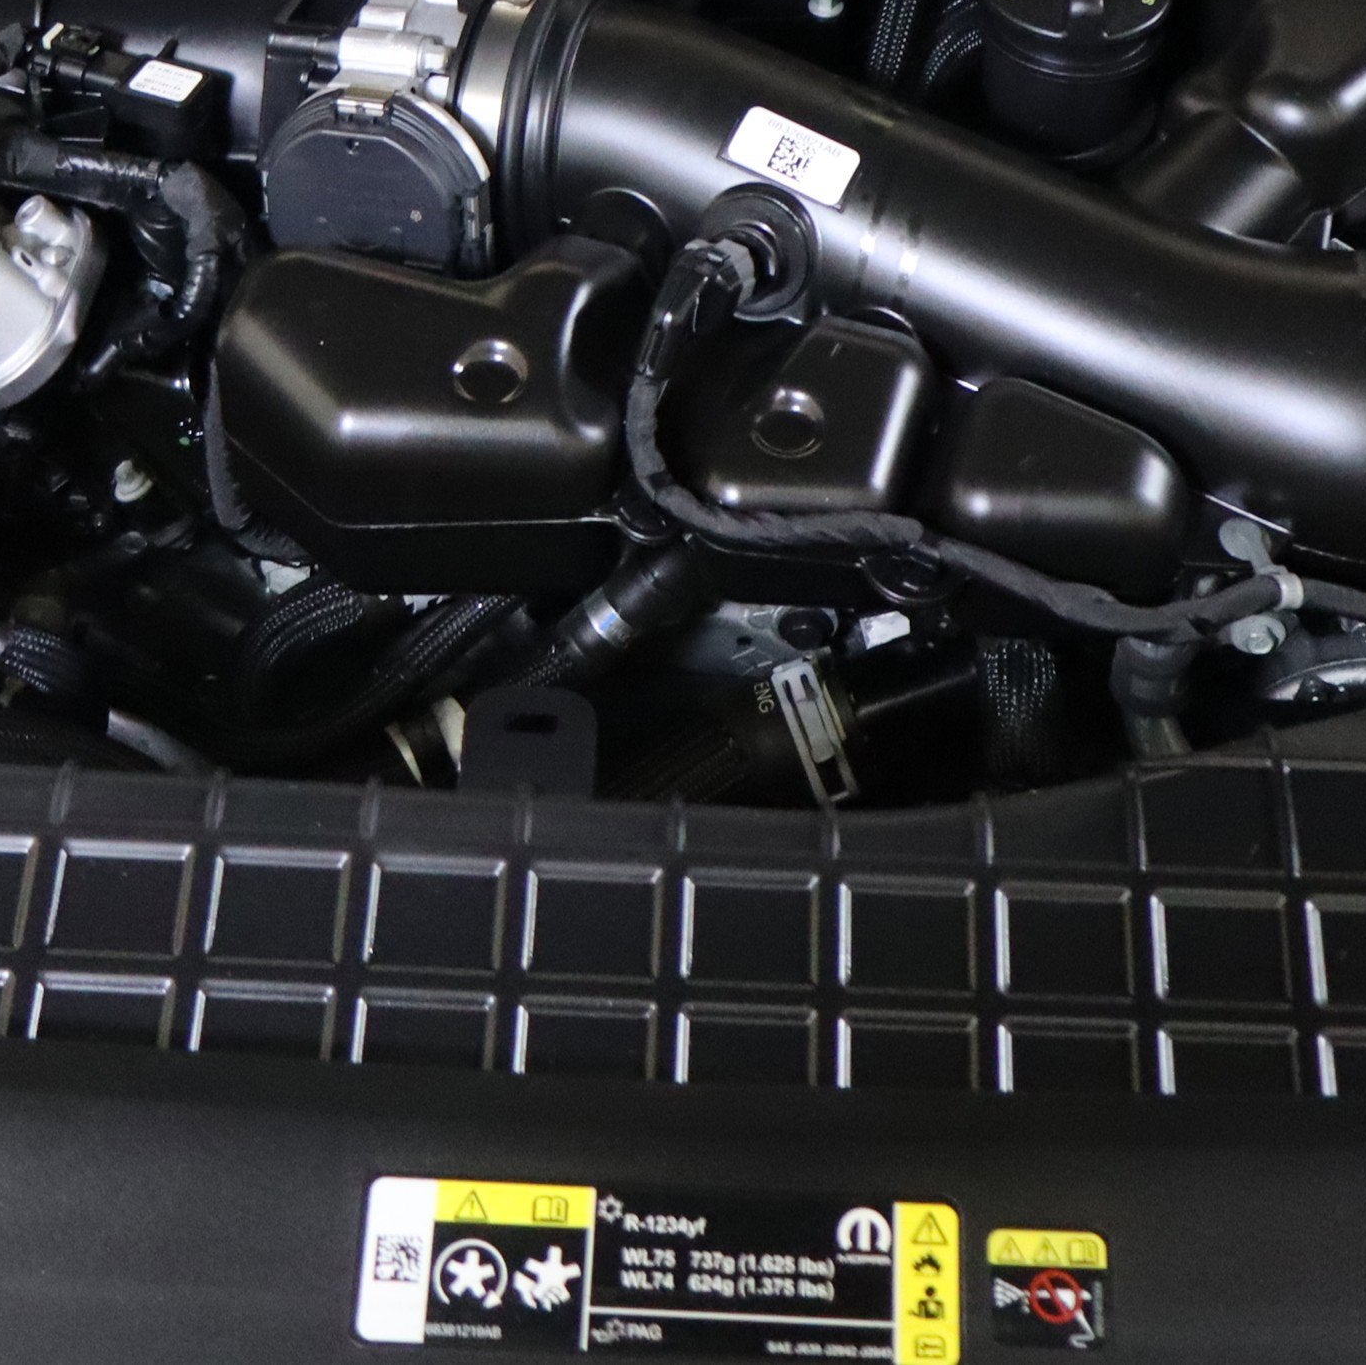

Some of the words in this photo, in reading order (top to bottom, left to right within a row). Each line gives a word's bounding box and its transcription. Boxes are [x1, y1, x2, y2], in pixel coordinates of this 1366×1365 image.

[753, 680, 775, 714] ENG
[623, 1212, 707, 1239] R-1234yf
[620, 1246, 677, 1268] WL75
[689, 1249, 736, 1275] 737g
[737, 1252, 796, 1276] (1.625
[797, 1255, 836, 1280] lbs)
[619, 1268, 675, 1291] WL74
[686, 1272, 735, 1298] 624g
[736, 1275, 796, 1298] (1.375
[796, 1278, 836, 1302] lbs)
